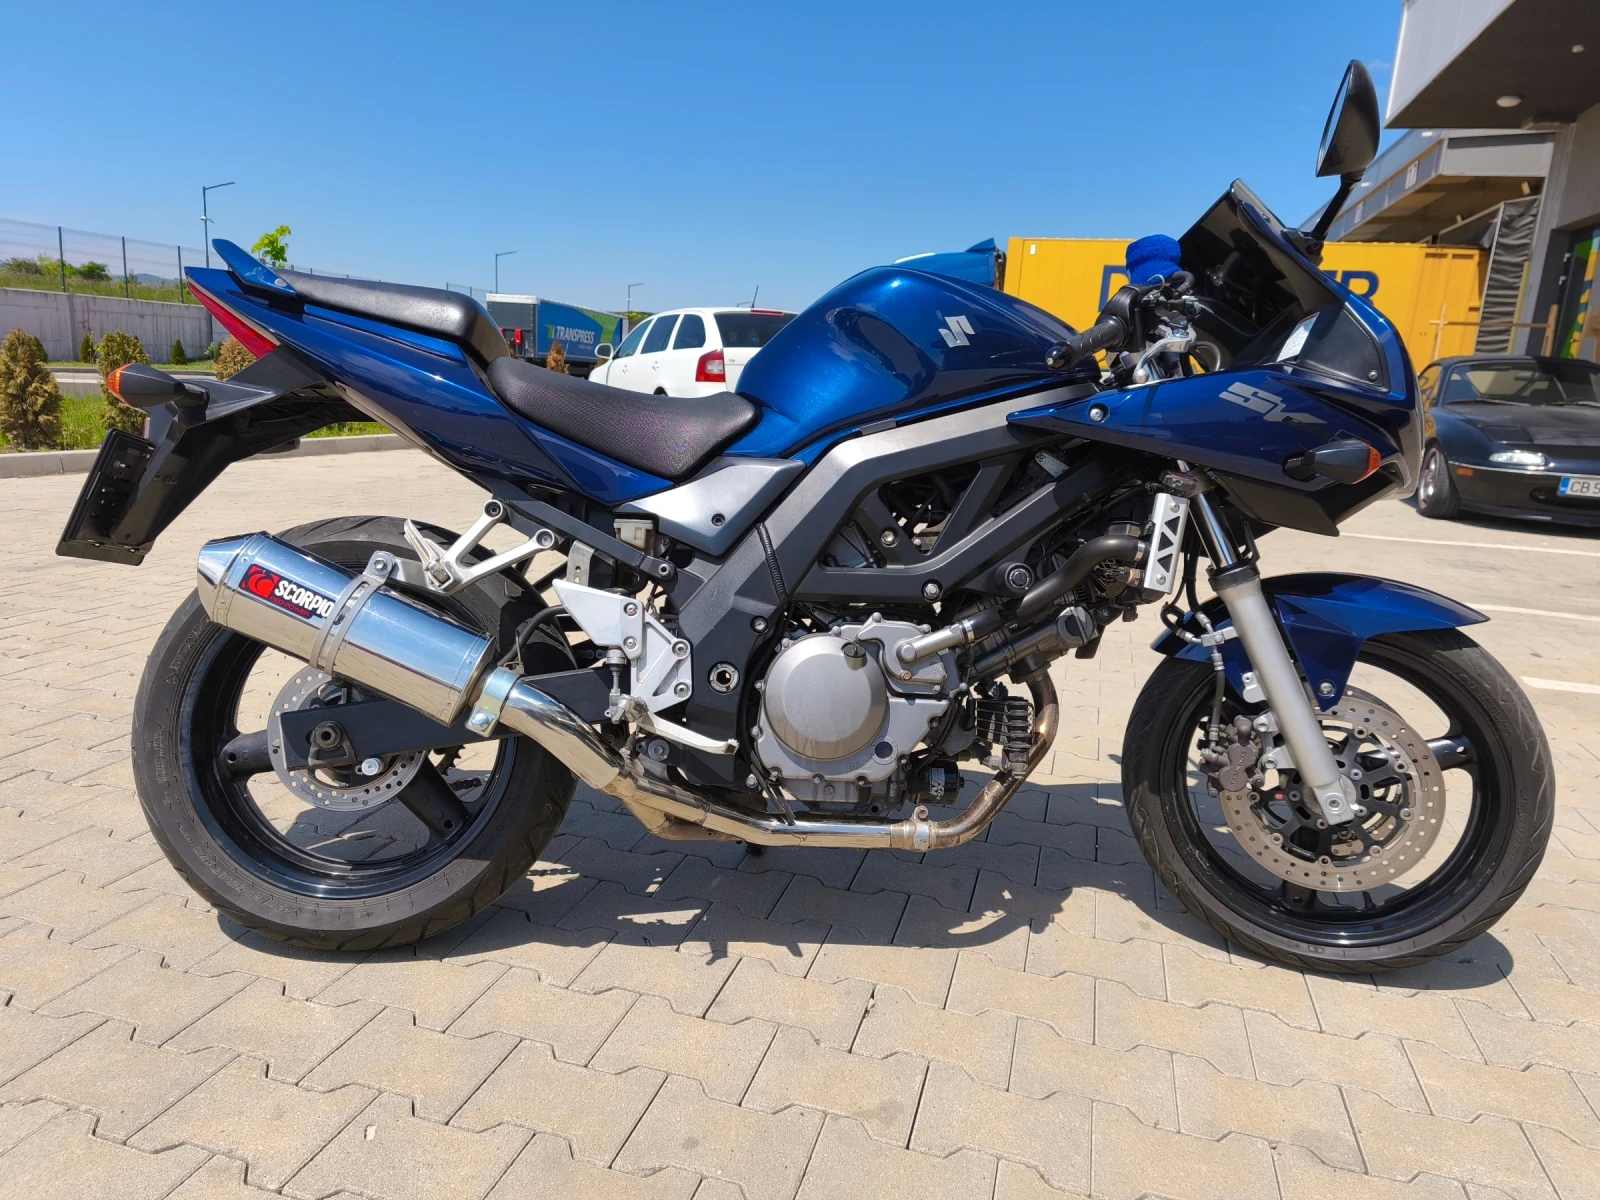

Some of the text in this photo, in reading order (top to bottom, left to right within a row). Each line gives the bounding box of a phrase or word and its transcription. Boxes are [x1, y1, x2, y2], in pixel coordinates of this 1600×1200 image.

[556, 325, 595, 344] TRANSPRESS
[1570, 480, 1591, 494] CB
[274, 579, 335, 617] SCORPIO
[284, 601, 311, 618] POWER
[1229, 751, 1246, 785] TOKICO
